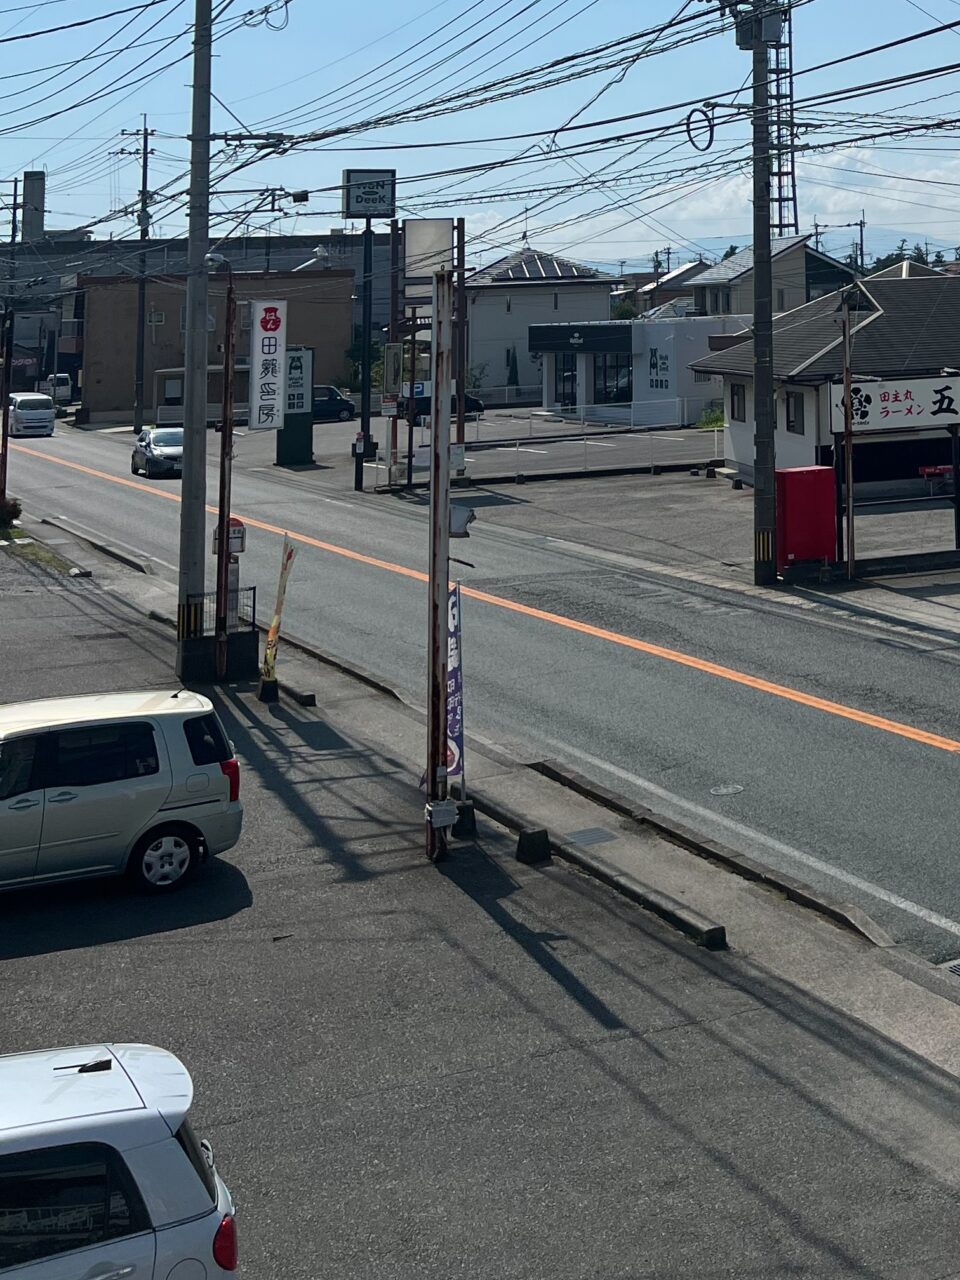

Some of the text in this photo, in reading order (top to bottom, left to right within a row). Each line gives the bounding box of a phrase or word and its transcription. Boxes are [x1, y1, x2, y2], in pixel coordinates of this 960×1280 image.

[879, 389, 915, 403] 田主丸
[879, 404, 926, 419] ラーメン
